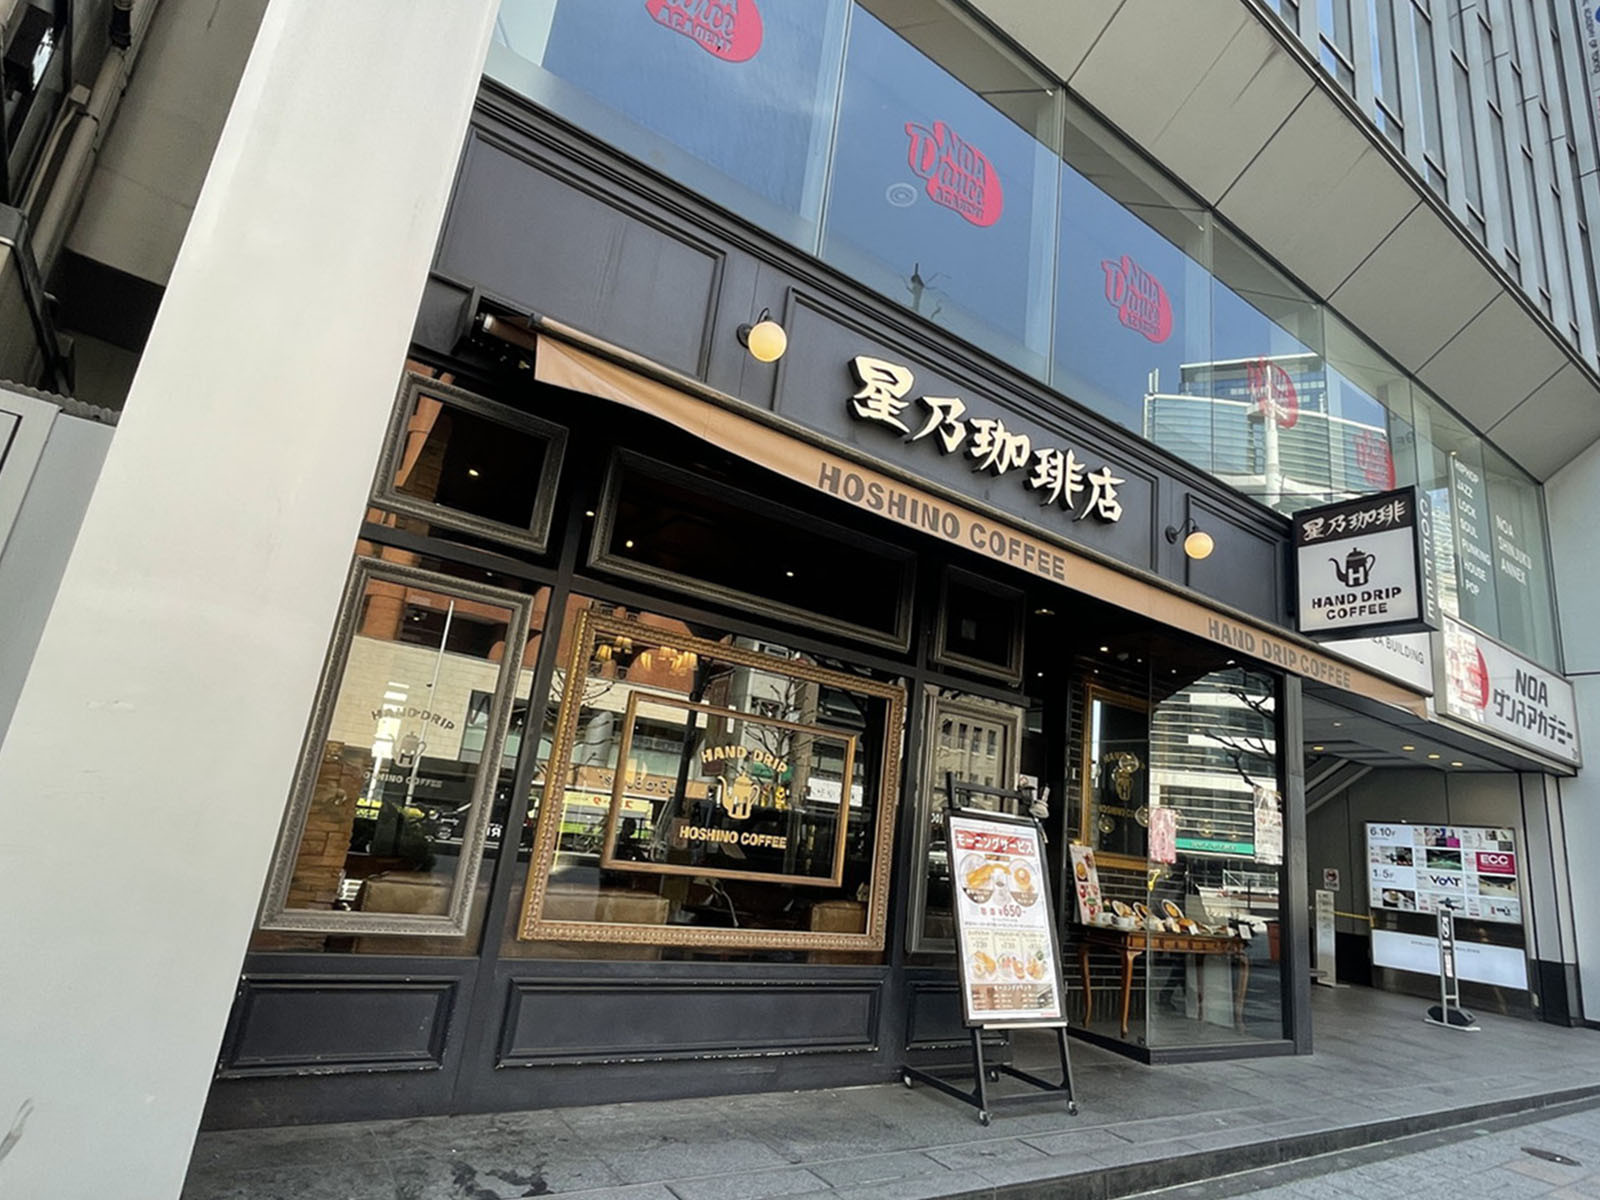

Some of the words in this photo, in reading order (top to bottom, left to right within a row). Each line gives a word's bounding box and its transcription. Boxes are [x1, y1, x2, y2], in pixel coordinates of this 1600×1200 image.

[853, 355, 1126, 522] 星乃珈琲店
[818, 462, 961, 540] HOSHINO
[969, 522, 1066, 581] COFFEE
[1303, 500, 1406, 541] 星乃珈琲
[1420, 498, 1437, 620] COFFEE
[1312, 593, 1357, 609] HAND
[1361, 586, 1402, 602] DRIP
[1326, 602, 1388, 620] COFFEE
[1209, 617, 1256, 653] HAND
[1262, 639, 1298, 670] DRIP
[1300, 654, 1351, 689] COFFEE
[1515, 668, 1548, 708] NOA
[701, 745, 748, 763] HAND
[753, 749, 788, 773] DRIP
[679, 825, 739, 844] HOSHINO
[740, 831, 787, 850] COFFEE
[1480, 854, 1509, 865] ECC
